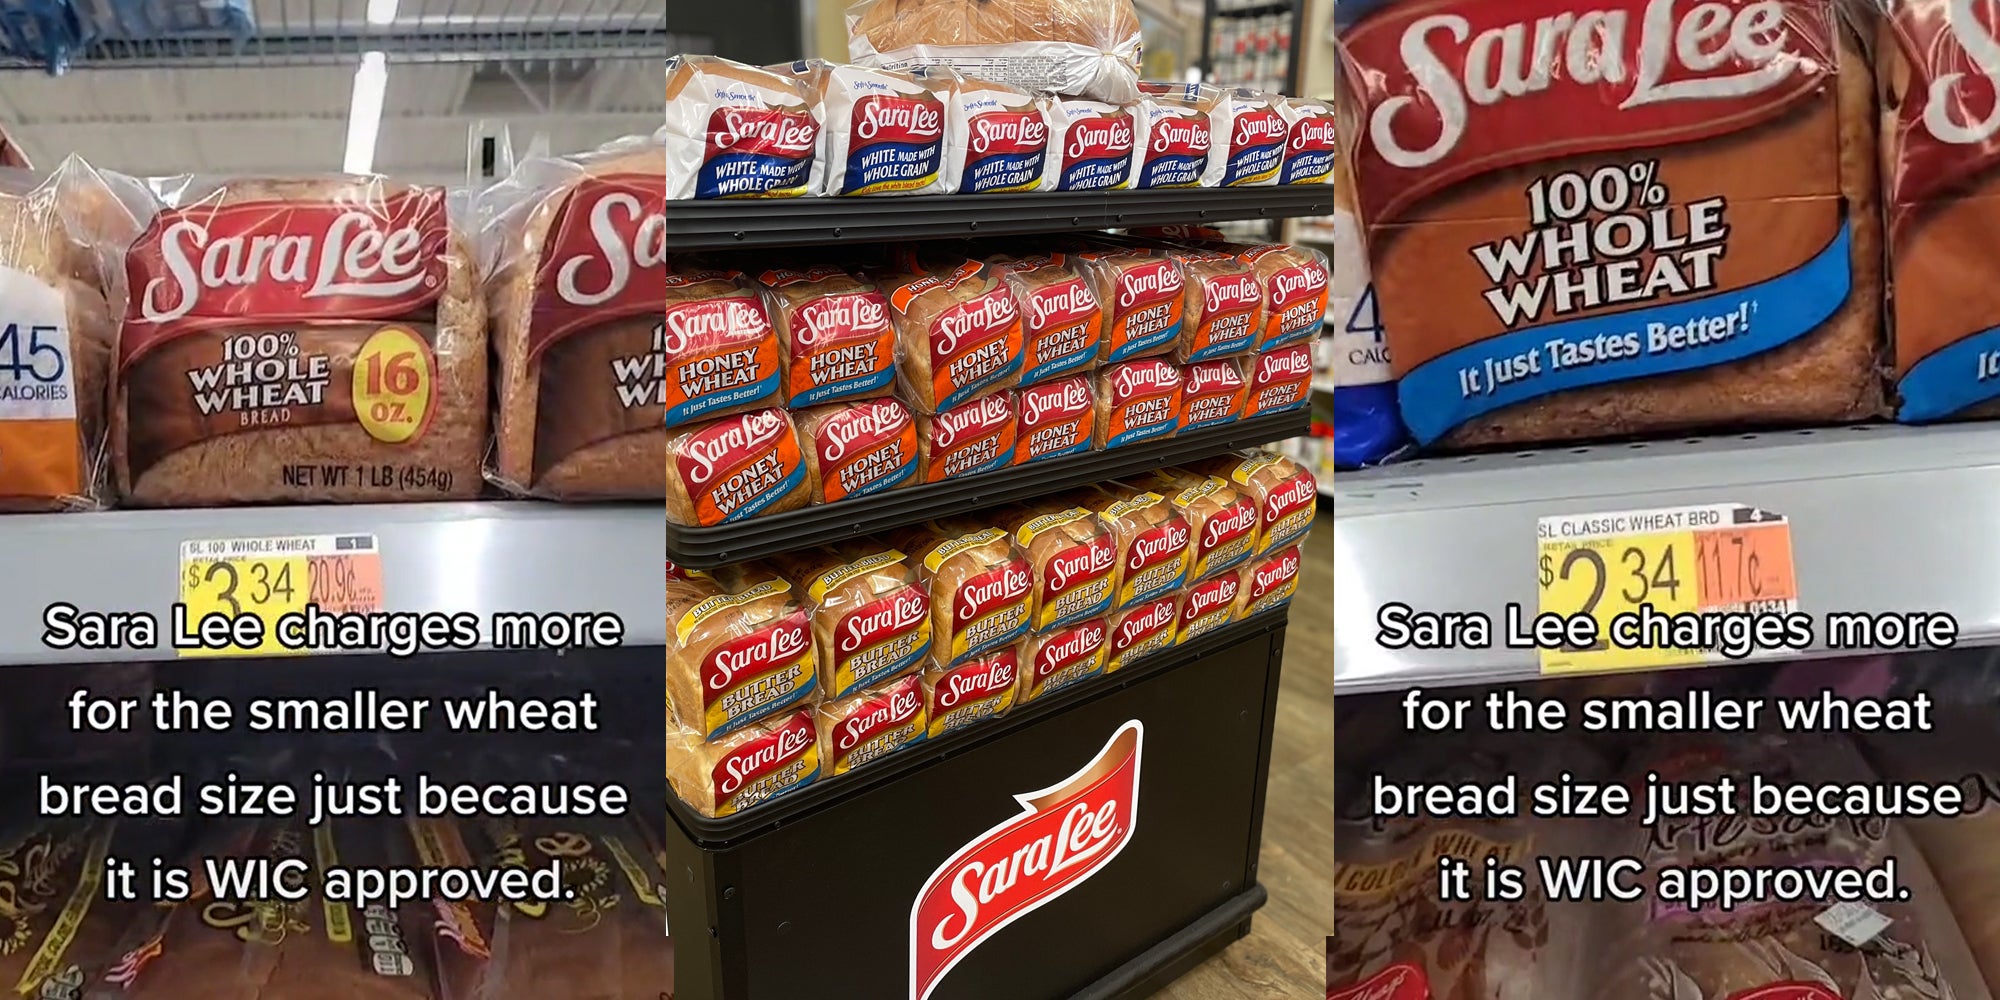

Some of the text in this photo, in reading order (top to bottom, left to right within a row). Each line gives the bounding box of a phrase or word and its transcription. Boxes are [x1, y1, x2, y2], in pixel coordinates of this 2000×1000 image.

[1370, 0, 1627, 168] Sara
[1619, 0, 1801, 110] Lee
[715, 112, 814, 150] Sara Lee
[858, 102, 939, 139] Sara Lee
[973, 116, 1044, 153] Sara Lee
[862, 145, 936, 170] WHITE MADE WITH
[1068, 122, 1131, 158] Sara Lee
[716, 161, 757, 179] WHITE
[863, 161, 930, 183] WHOLE GRAIN
[974, 153, 1040, 180] WHITE MADE WITH
[974, 168, 1034, 192] WHOLE GRAIN
[718, 178, 763, 195] WHOLE
[1526, 159, 1669, 225] 100%
[557, 192, 666, 305] Sa
[1471, 197, 1729, 285] WHOLE
[142, 213, 432, 322] Sara Lee
[1120, 265, 1181, 307] Sara Lee
[1483, 244, 1725, 329] WHEAT
[798, 298, 885, 345] Sara Lee
[1030, 284, 1096, 330] Sara Lee
[1126, 301, 1173, 329] HONEY
[1346, 282, 1385, 343] 4
[666, 310, 726, 354] Sara
[725, 302, 766, 338] Lee
[1037, 321, 1090, 351] HONEY
[1125, 315, 1172, 341] WHEAT
[0, 324, 64, 381] 45
[223, 333, 299, 361] 100%
[678, 346, 759, 383] HONEY
[810, 340, 878, 372] HONEY
[1036, 335, 1089, 364] WHEAT
[1458, 366, 1482, 399] It
[1483, 346, 1541, 393] Just
[1545, 327, 1641, 370] Tastes
[188, 356, 331, 392] WHOLE
[366, 351, 419, 395] 16
[680, 363, 760, 399] WHEAT
[810, 356, 879, 386] WHEAT
[1119, 361, 1180, 398] Sara Lee
[0, 385, 67, 400] ALORIES
[194, 380, 331, 415] WHEAT
[683, 385, 760, 416] It Just Tastes Better!
[809, 393, 815, 401] It
[815, 388, 830, 399] Just
[832, 384, 853, 393] Tastes
[1125, 395, 1172, 419] HONEY
[240, 408, 290, 426] BREAD
[370, 403, 412, 423] OZ.
[1124, 407, 1171, 430] WHEAT
[690, 410, 781, 483] Sara Lee
[283, 464, 453, 491] NET WT 1 LB (454g)
[712, 448, 778, 504] HONEY
[716, 462, 784, 515] WHEAT
[1538, 524, 1557, 538] SL
[1561, 518, 1625, 537] CLASSIC
[1629, 513, 1683, 531] WHEAT
[1689, 510, 1719, 526] BRD
[207, 544, 225, 553] 100
[232, 541, 273, 552] WHOLE
[277, 539, 316, 550] WHEAT
[1050, 545, 1114, 591] Sara Lee
[960, 569, 1028, 620] Sara Lee
[1055, 578, 1109, 612] BUTTER
[1056, 592, 1103, 620] BREAD
[841, 597, 925, 652] Sara Lee
[966, 603, 1026, 640] BUTTER
[967, 618, 1019, 650] BREAD
[709, 627, 805, 690] Sara Lee
[850, 631, 919, 671] BUTTER
[854, 645, 912, 680] BREAD
[722, 663, 802, 712] BUTTER
[727, 680, 796, 720] BREAD
[931, 796, 1120, 951] Sara Lee
